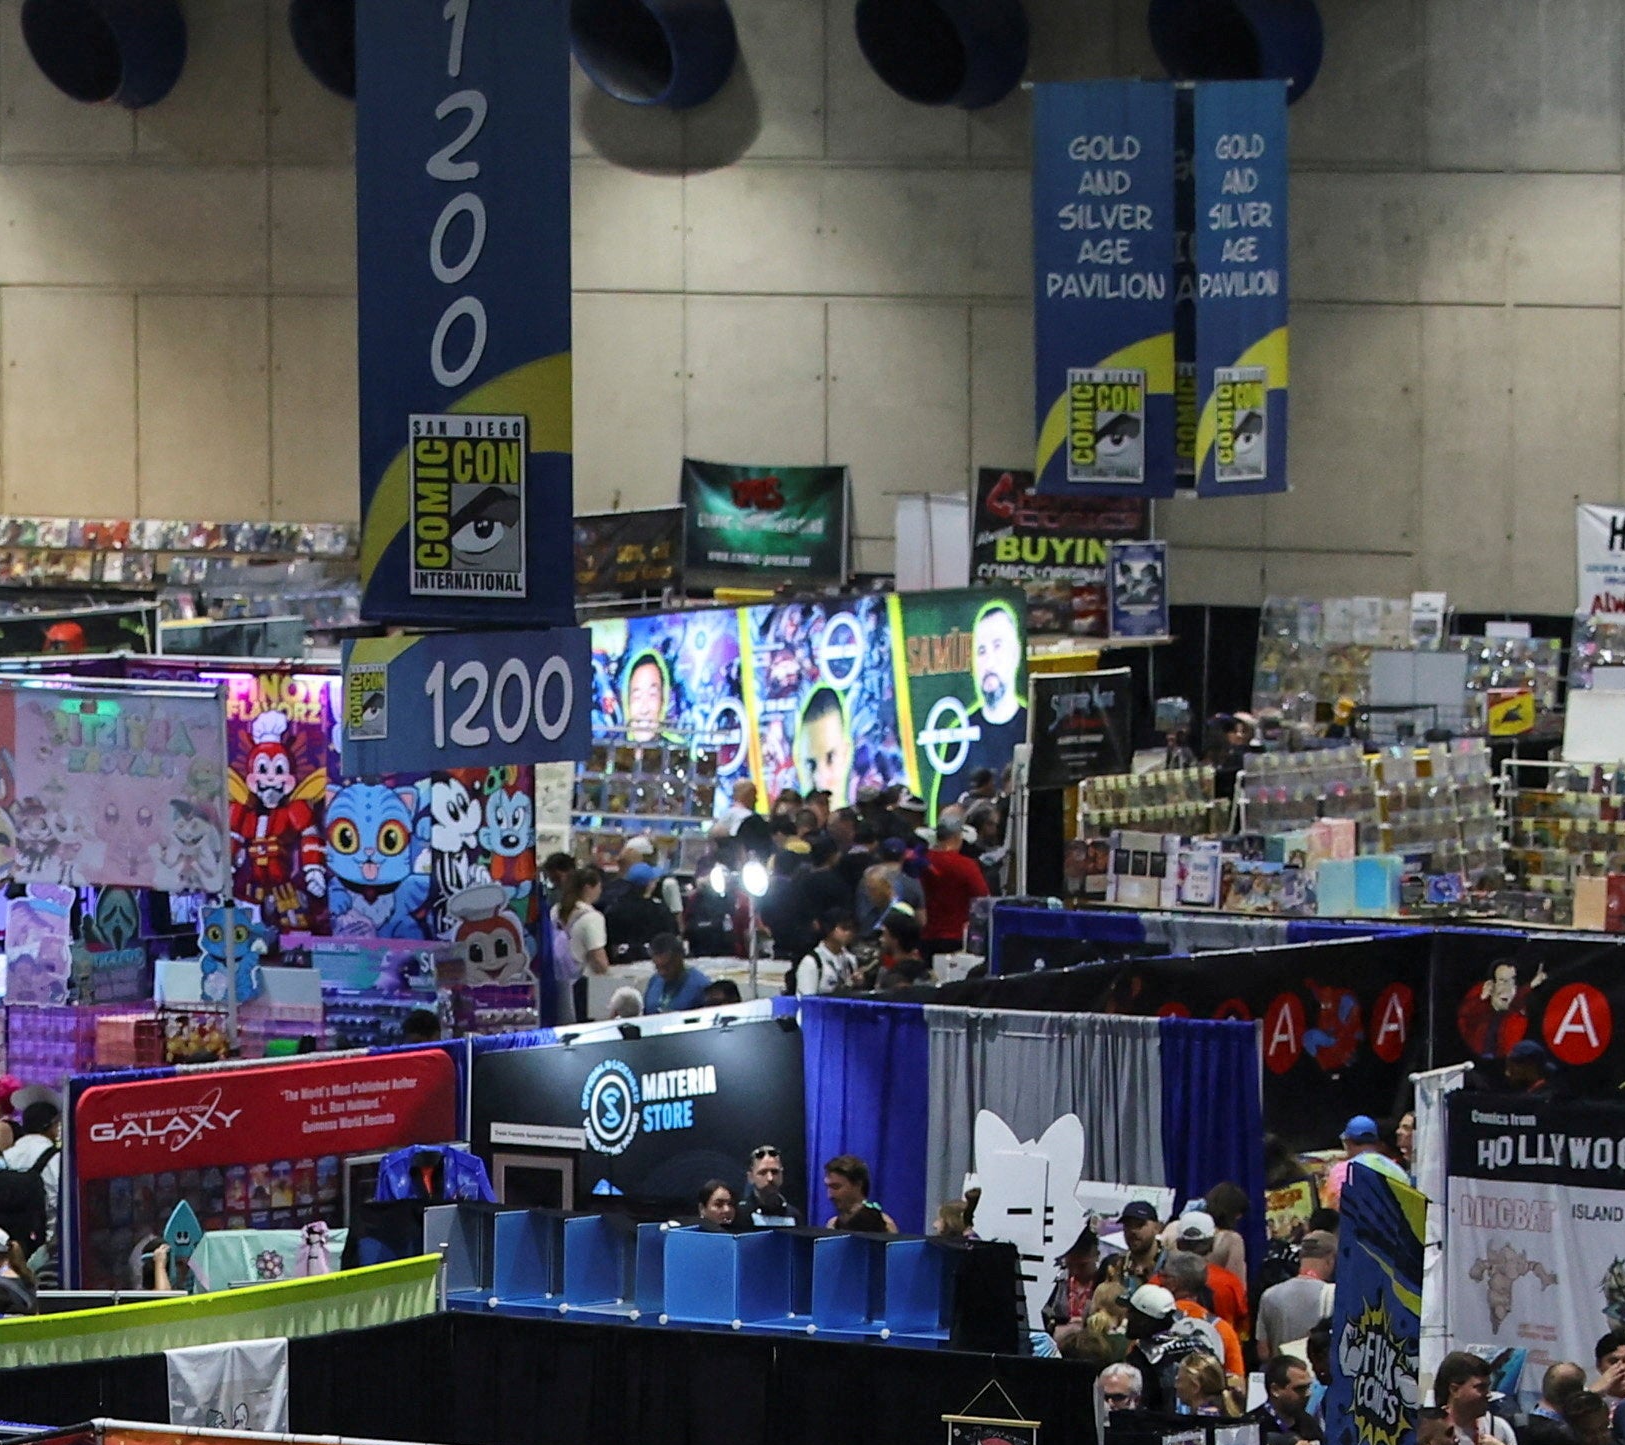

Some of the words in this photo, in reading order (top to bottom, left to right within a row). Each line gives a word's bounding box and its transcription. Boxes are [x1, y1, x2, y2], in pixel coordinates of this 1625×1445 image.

[1068, 135, 1141, 162] GOLD
[1215, 132, 1265, 160] GOLD
[1080, 169, 1132, 196] AND
[1221, 167, 1257, 195] AND
[1057, 202, 1153, 232] SILVER
[1208, 200, 1273, 229] SILVER
[1077, 236, 1134, 265] AGE
[1220, 235, 1259, 264] AGE
[1046, 272, 1166, 300] PAVILION
[1199, 271, 1279, 299] PAVILION
[1097, 384, 1141, 414] CON
[412, 418, 450, 436] SAN
[465, 418, 523, 437] DIEGO
[1071, 384, 1096, 466] COMIC
[452, 440, 519, 483] CON
[414, 439, 451, 565] COMIC
[413, 571, 523, 593] INTERNATIONAL
[425, 655, 573, 748] 1200
[641, 1064, 719, 1103] MATERIA
[89, 1107, 242, 1143] GALAXY
[336, 1115, 362, 1130] World
[362, 1112, 395, 1127] Records
[641, 1102, 694, 1134] STORE
[1471, 1109, 1508, 1125] Comics
[1508, 1112, 1537, 1127] from
[1461, 1194, 1558, 1234] DINGBAT
[1571, 1202, 1624, 1222] ISLAND
